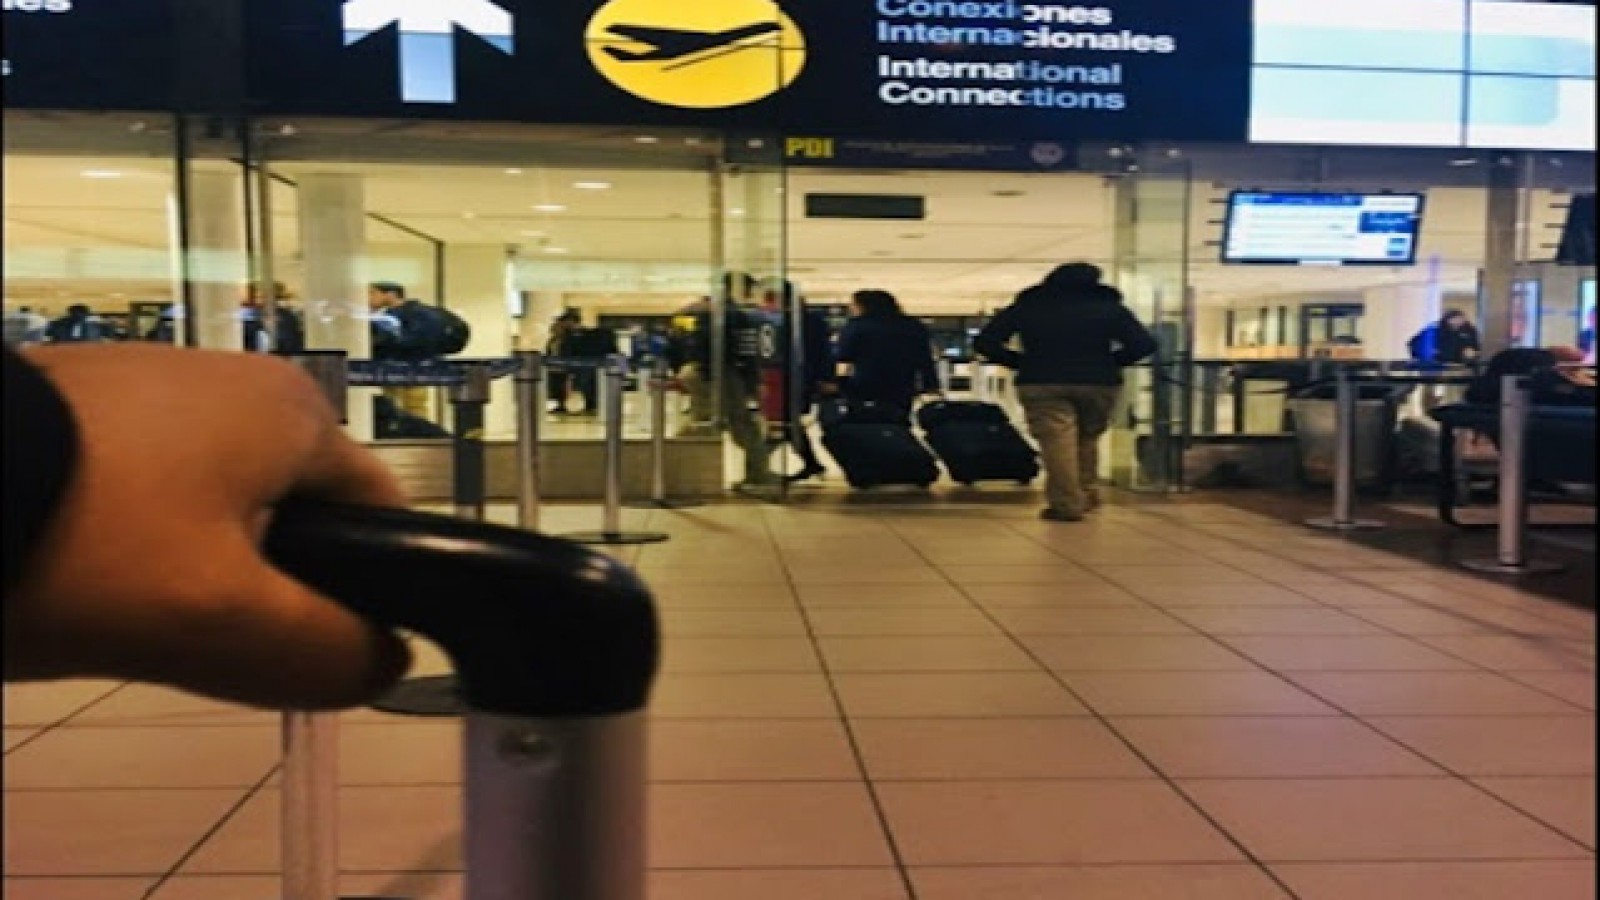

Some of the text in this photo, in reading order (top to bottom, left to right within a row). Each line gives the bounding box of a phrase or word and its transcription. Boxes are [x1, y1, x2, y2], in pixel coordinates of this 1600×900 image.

[878, 0, 1112, 25] Conexiones
[877, 21, 1176, 52] Internacionales
[878, 55, 1122, 84] International
[879, 80, 1126, 110] Connections
[785, 138, 832, 158] PDI
